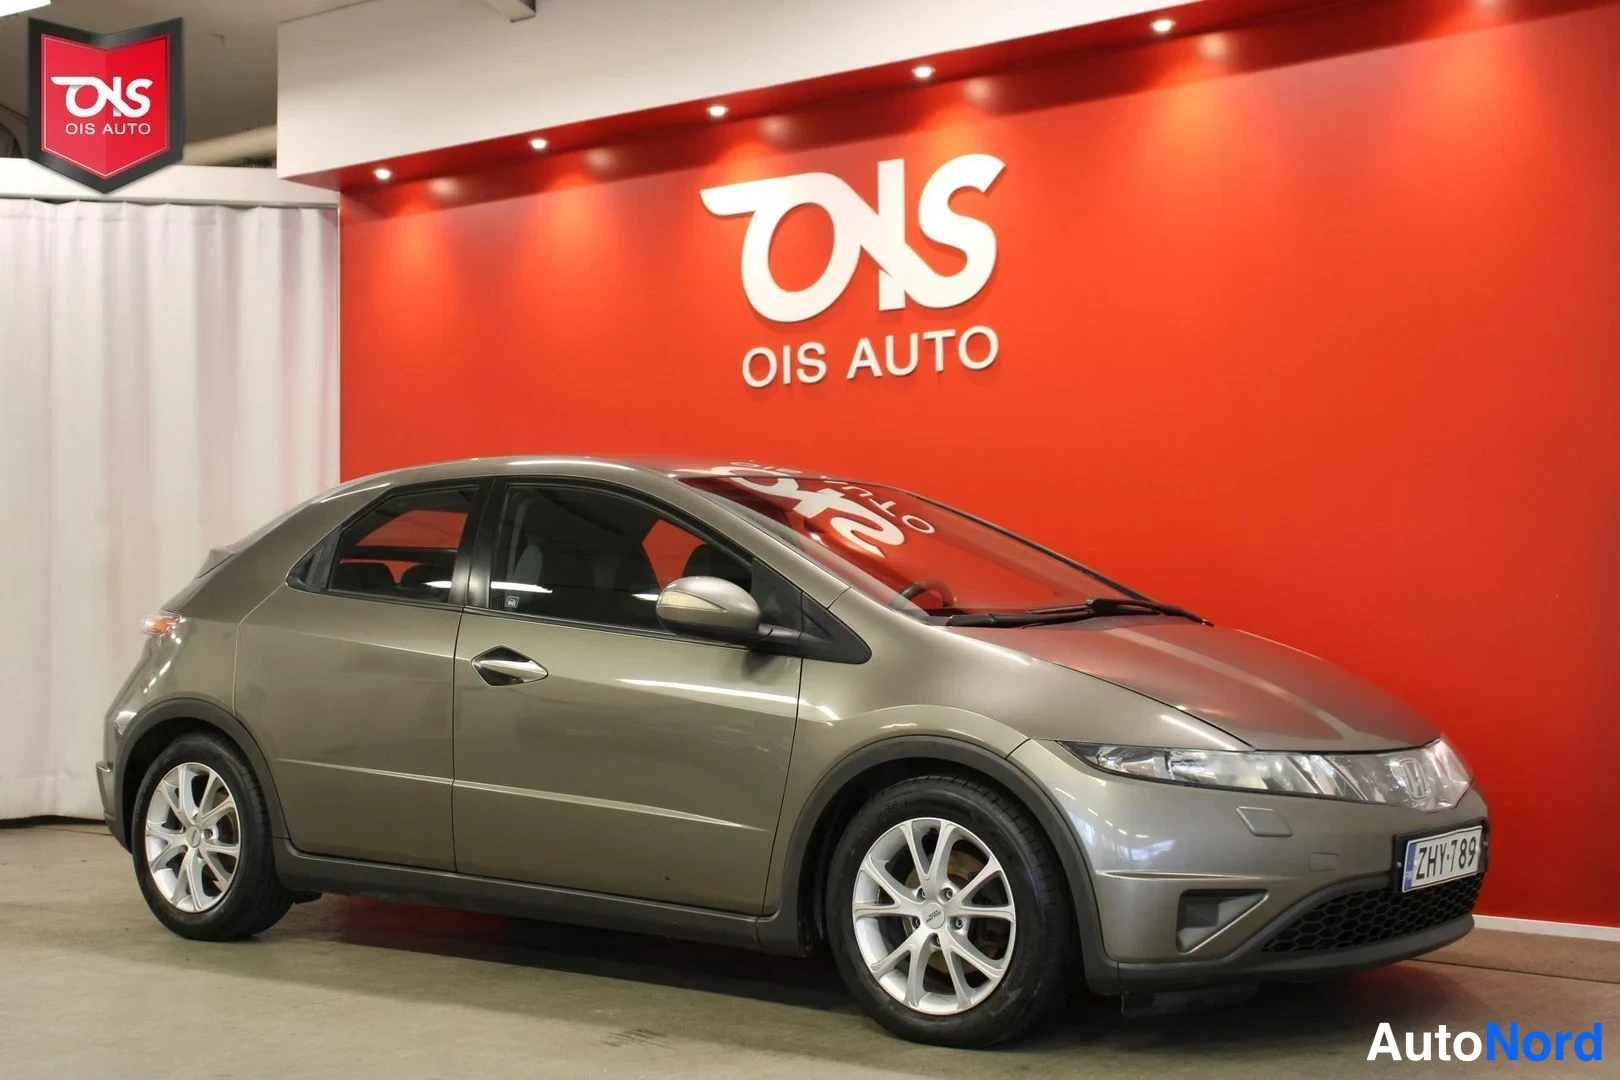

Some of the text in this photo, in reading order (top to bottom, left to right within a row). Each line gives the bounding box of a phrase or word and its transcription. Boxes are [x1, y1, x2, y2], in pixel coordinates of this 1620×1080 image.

[700, 153, 1006, 323] OIS
[742, 325, 999, 388] OIS AUTO
[1416, 836, 1477, 881] ZHY-789
